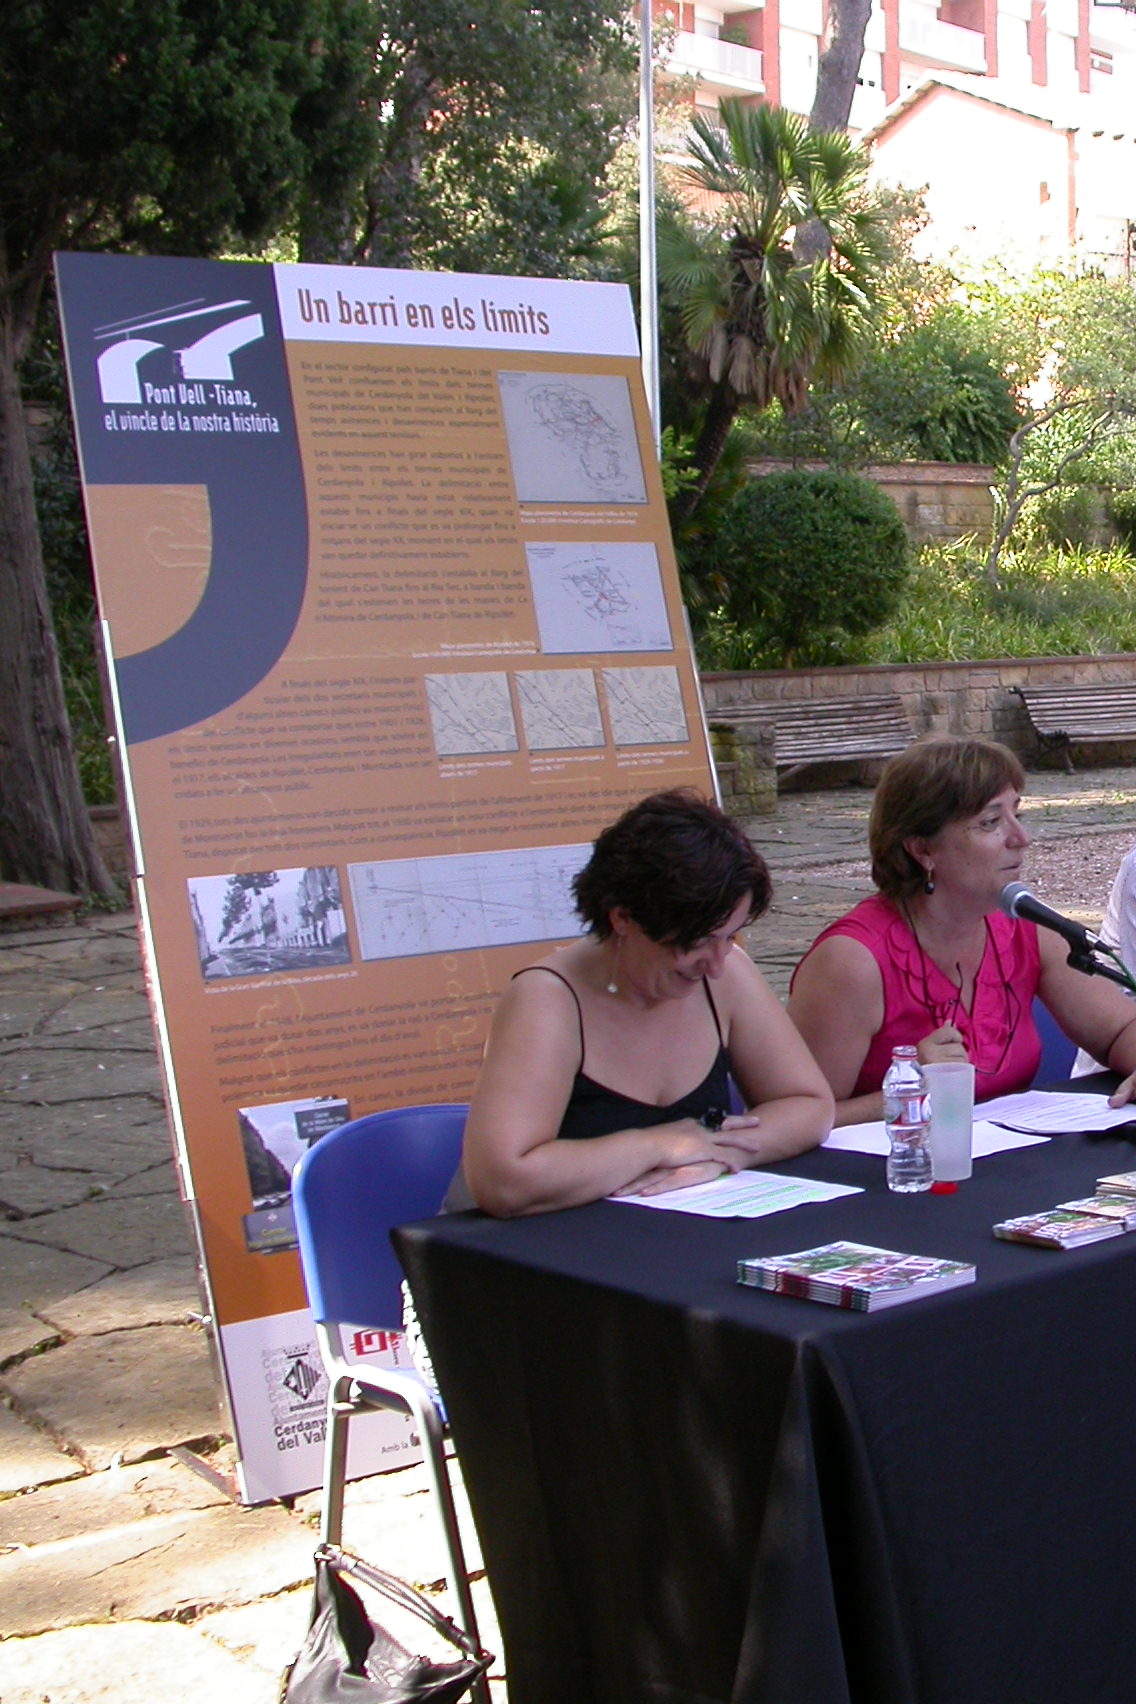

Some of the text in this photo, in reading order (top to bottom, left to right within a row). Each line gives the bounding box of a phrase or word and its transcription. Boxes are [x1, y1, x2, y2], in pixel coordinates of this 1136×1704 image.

[297, 288, 330, 323] Un
[337, 290, 399, 327] barri
[406, 302, 435, 329] en
[441, 297, 475, 331] els
[144, 382, 176, 404] Pont
[178, 383, 206, 405] Vell
[104, 410, 119, 431] el
[119, 410, 158, 431] vincle
[160, 411, 176, 431] de
[177, 411, 191, 431] la
[193, 413, 231, 431] nostra
[274, 1419, 327, 1437] Cerdany
[277, 1428, 327, 1451] del Val
